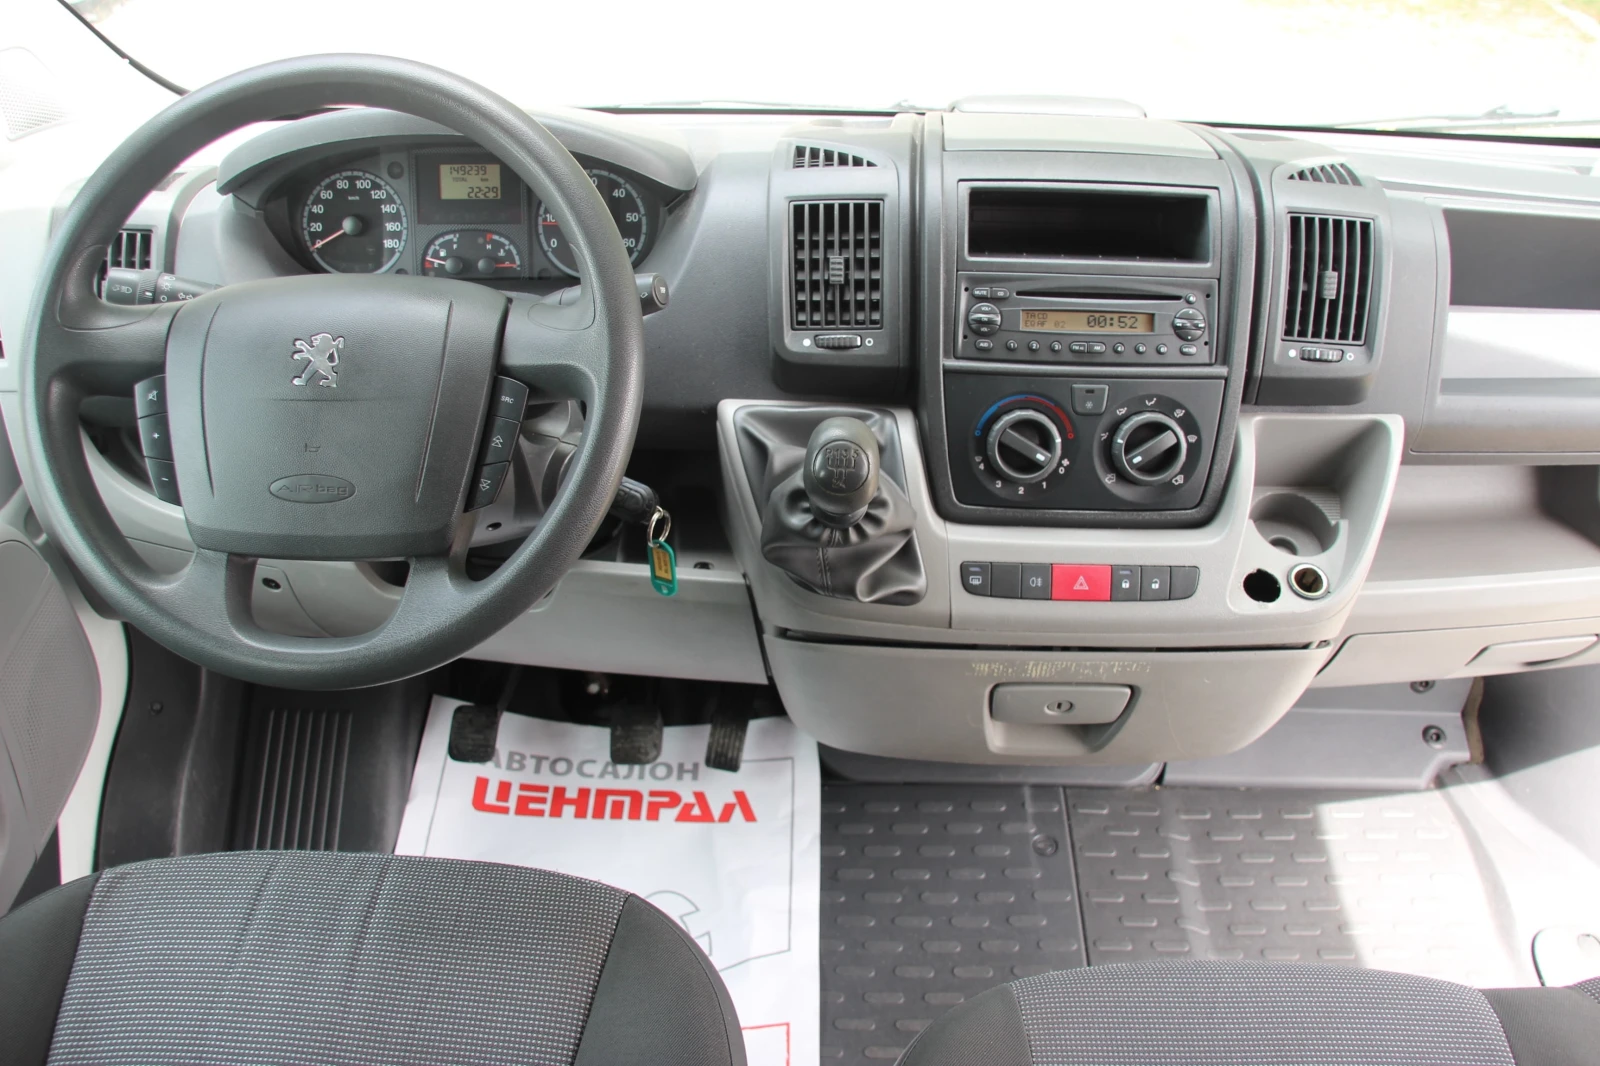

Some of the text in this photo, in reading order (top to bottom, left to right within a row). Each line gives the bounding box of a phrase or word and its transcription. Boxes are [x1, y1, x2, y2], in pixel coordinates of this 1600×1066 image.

[450, 165, 487, 176] 149239
[336, 180, 349, 189] 80
[355, 180, 371, 189] 100
[320, 190, 333, 199] 60
[370, 190, 387, 199] 120
[612, 189, 626, 198] 40
[311, 204, 324, 213] 40
[380, 204, 397, 213] 140
[626, 213, 639, 222] 50
[310, 222, 323, 231] 20
[385, 222, 401, 231] 160
[383, 239, 399, 248] 180
[550, 238, 557, 248] 0
[1087, 314, 1138, 329] 00:52
[501, 395, 514, 404] SRC
[1042, 481, 1047, 489] 1
[1018, 486, 1024, 495] 2
